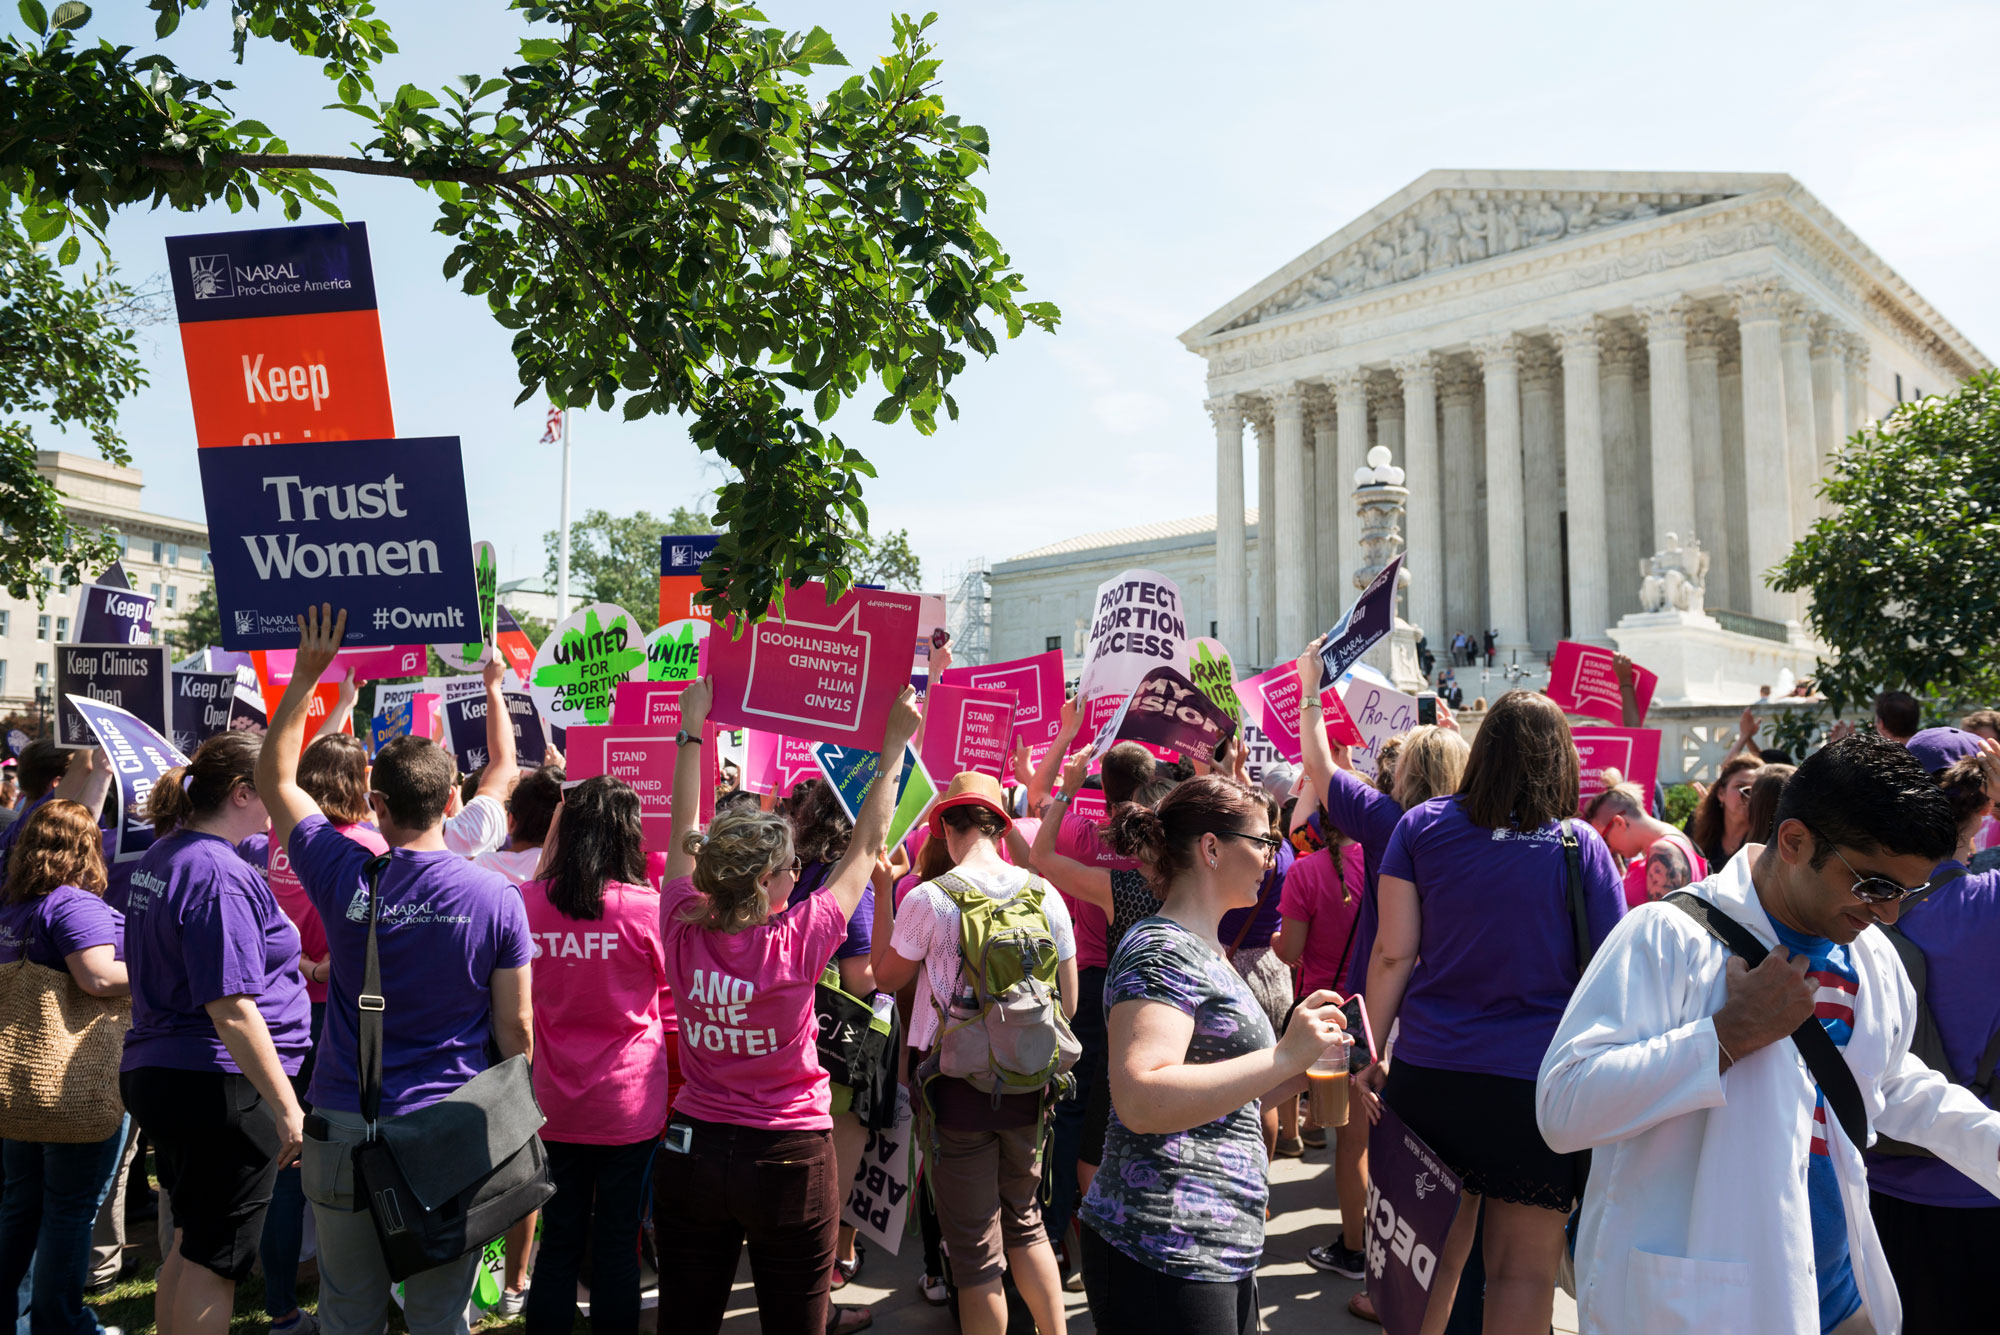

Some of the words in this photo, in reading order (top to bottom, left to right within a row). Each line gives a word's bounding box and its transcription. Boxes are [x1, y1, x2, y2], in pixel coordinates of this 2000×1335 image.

[235, 262, 299, 282] NARAL
[237, 282, 300, 296] Pro-Choice
[304, 278, 351, 292] America
[241, 353, 330, 412] Keep
[262, 473, 407, 522] Trust
[240, 533, 443, 580] Women
[104, 593, 144, 623] Keep
[1099, 581, 1176, 615] PROTECT
[260, 614, 297, 626] NARAL
[372, 606, 465, 631] #OwnIt
[1090, 606, 1185, 643] ABORTION
[553, 626, 629, 666] UNITED
[647, 642, 699, 665] UNITE
[760, 631, 859, 658] PARENTHOOD
[1093, 631, 1175, 664] ACCESS
[1339, 634, 1365, 659] NARAL
[67, 650, 98, 680] Keep
[102, 650, 149, 676] Clinics
[580, 661, 609, 679] FOR
[660, 666, 688, 679] FOR
[788, 654, 857, 676] PLANNED
[1582, 667, 1605, 678] WITH
[1584, 659, 1612, 672] STAND
[180, 676, 218, 703] Keep
[554, 671, 631, 698] ABORTION
[817, 677, 855, 694] WITH
[1269, 682, 1298, 701] STAND
[461, 700, 488, 721] Kee
[551, 693, 616, 713] COVERA
[804, 693, 852, 713] STAND
[1096, 696, 1126, 708] PLANN
[1274, 695, 1297, 711] WITH
[652, 714, 679, 724] WITH
[967, 711, 995, 722] STAND
[1280, 705, 1301, 721] PLAN
[966, 723, 989, 734] WITH
[96, 716, 144, 775] Clinics
[785, 740, 814, 750] PLAN
[964, 735, 1000, 748] PLANNED
[611, 751, 647, 762] STAND
[867, 758, 877, 771] OF
[611, 765, 640, 777] WITH
[839, 753, 870, 792] NATIONAL
[625, 780, 662, 791] ANNED
[855, 776, 875, 804] JEWIS
[1079, 807, 1105, 817] STAND
[381, 914, 432, 925] Pro-Choice
[432, 913, 471, 924] America
[383, 902, 434, 917] NARAL
[530, 932, 619, 960] STAFF
[688, 969, 754, 1005] AND
[683, 1016, 778, 1056] VOTE!
[1366, 1175, 1437, 1292] DECI
